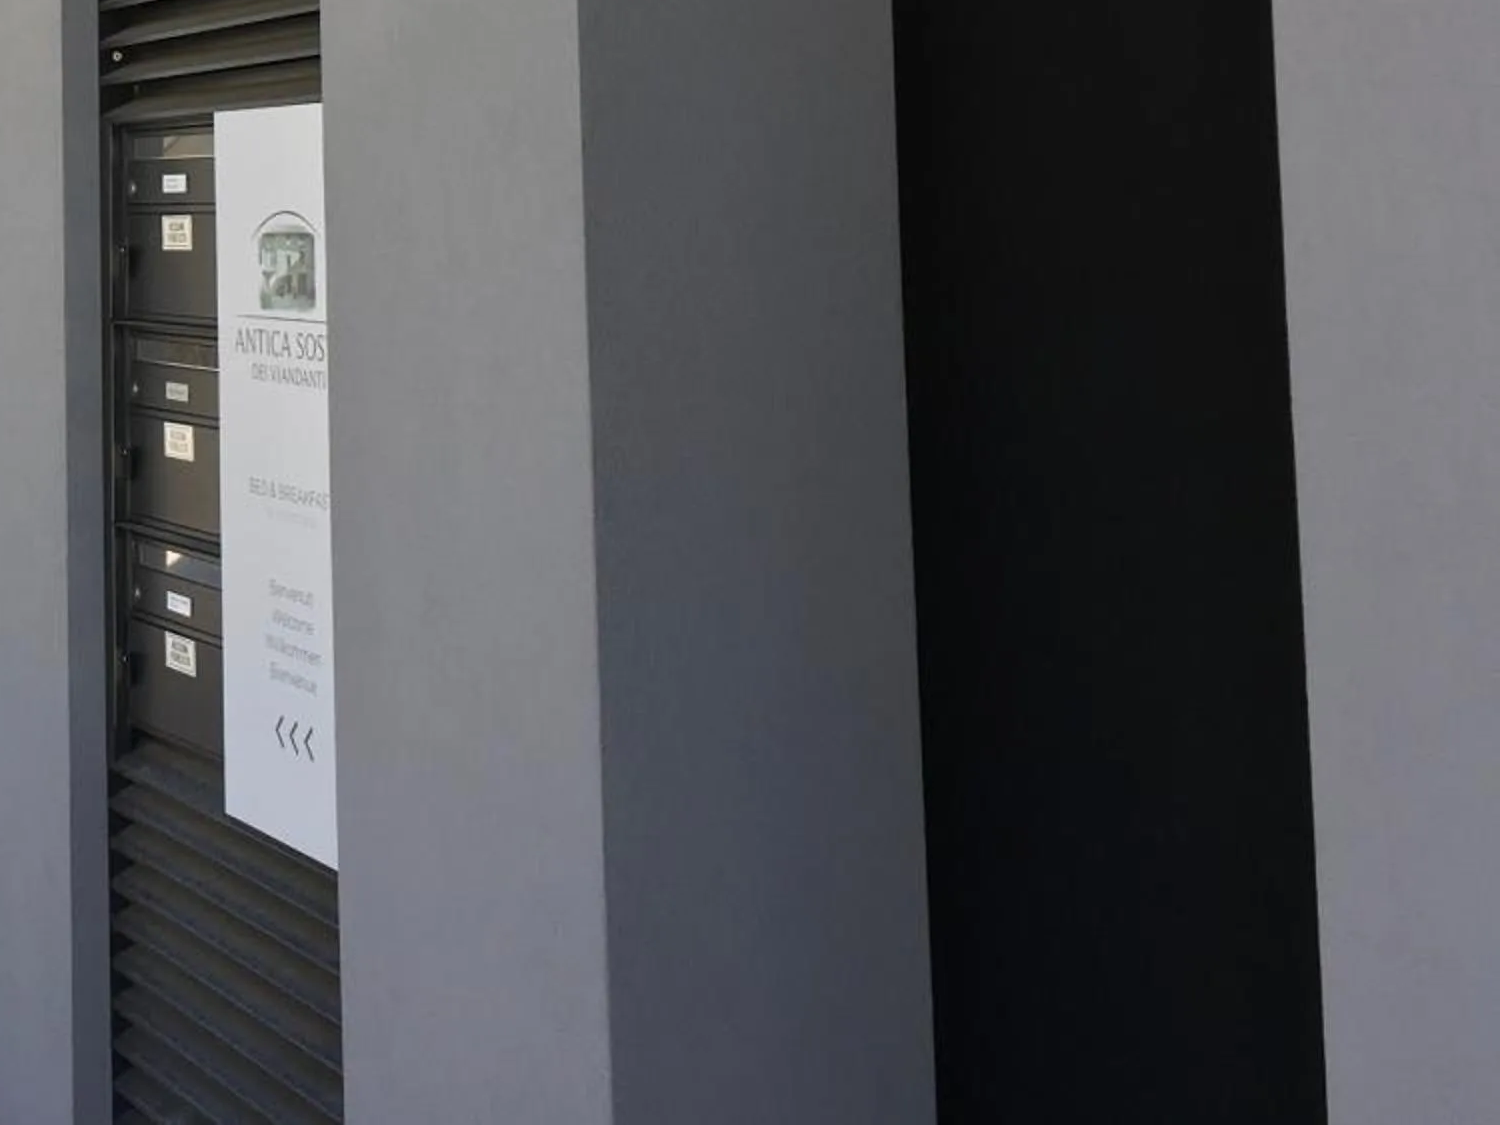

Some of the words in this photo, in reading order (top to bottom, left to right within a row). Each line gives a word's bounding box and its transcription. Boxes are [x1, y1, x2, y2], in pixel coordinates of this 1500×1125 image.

[235, 327, 291, 358] ANTICA
[296, 332, 325, 362] SOS
[269, 364, 327, 390] VIANDANTI
